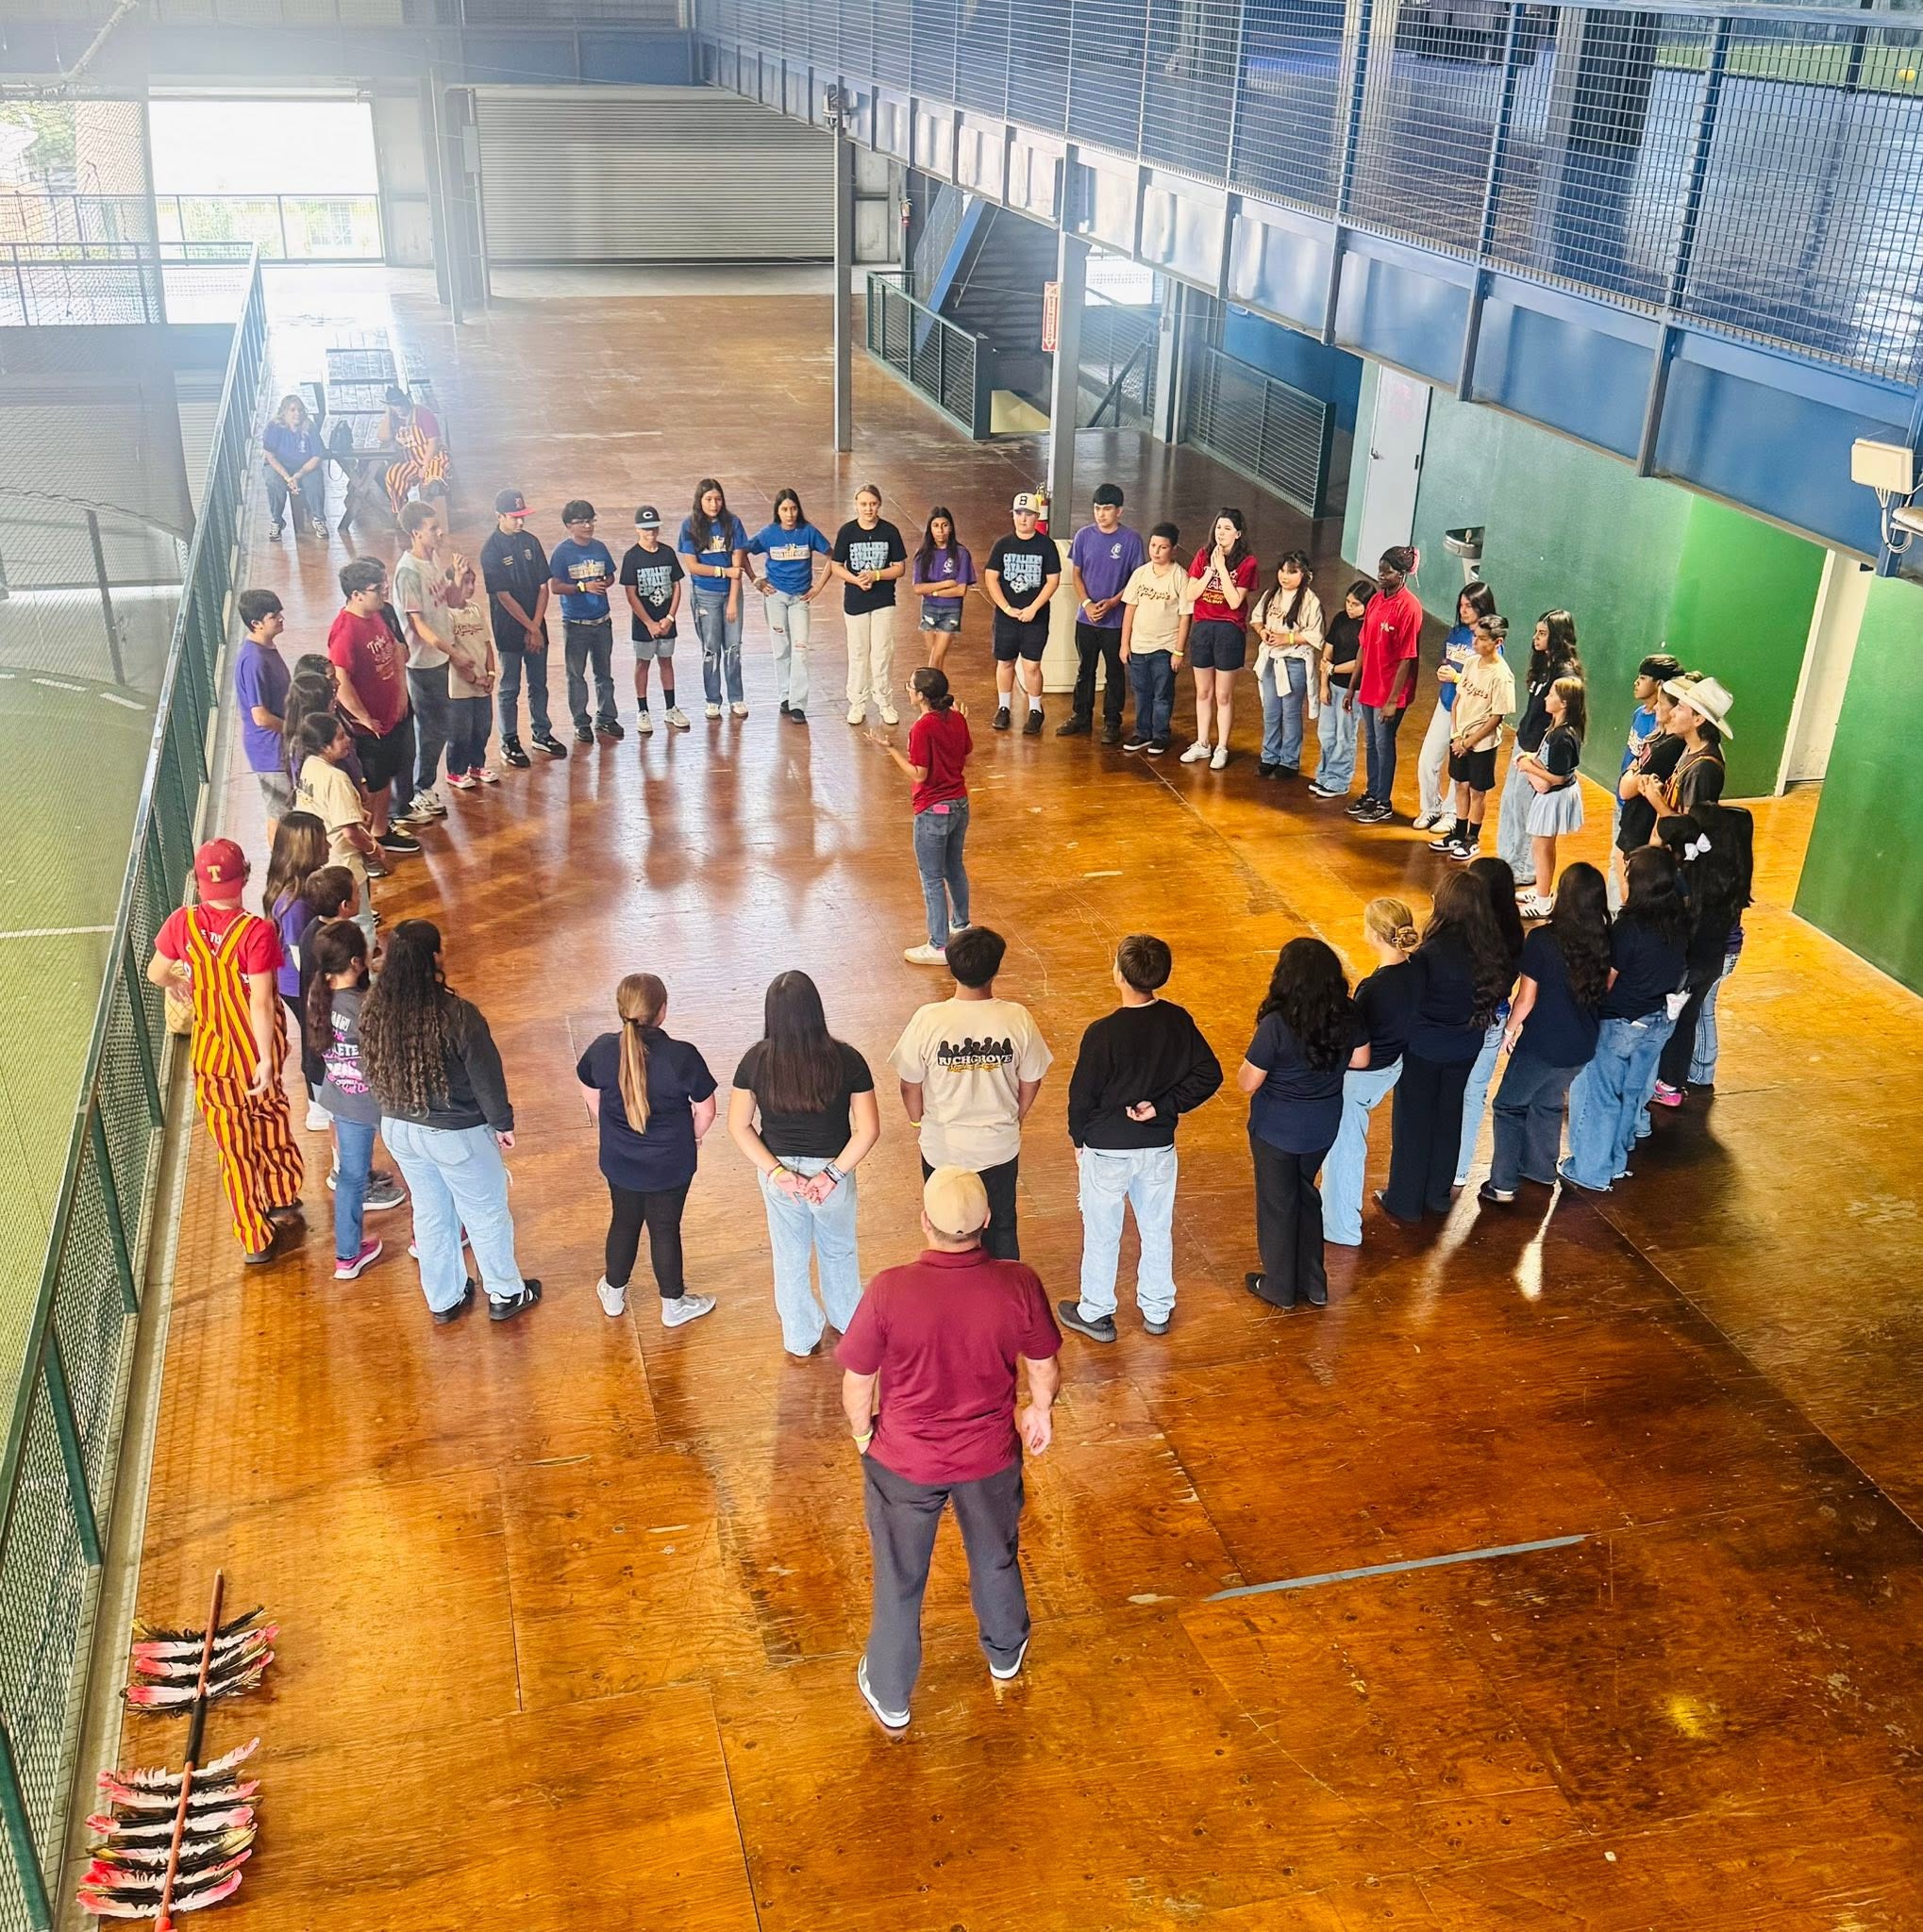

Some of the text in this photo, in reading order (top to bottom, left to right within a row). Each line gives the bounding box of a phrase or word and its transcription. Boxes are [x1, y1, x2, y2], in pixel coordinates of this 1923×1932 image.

[1019, 495, 1028, 506] B
[207, 865, 222, 883] T
[939, 1055, 1012, 1065] RICHGROVE
